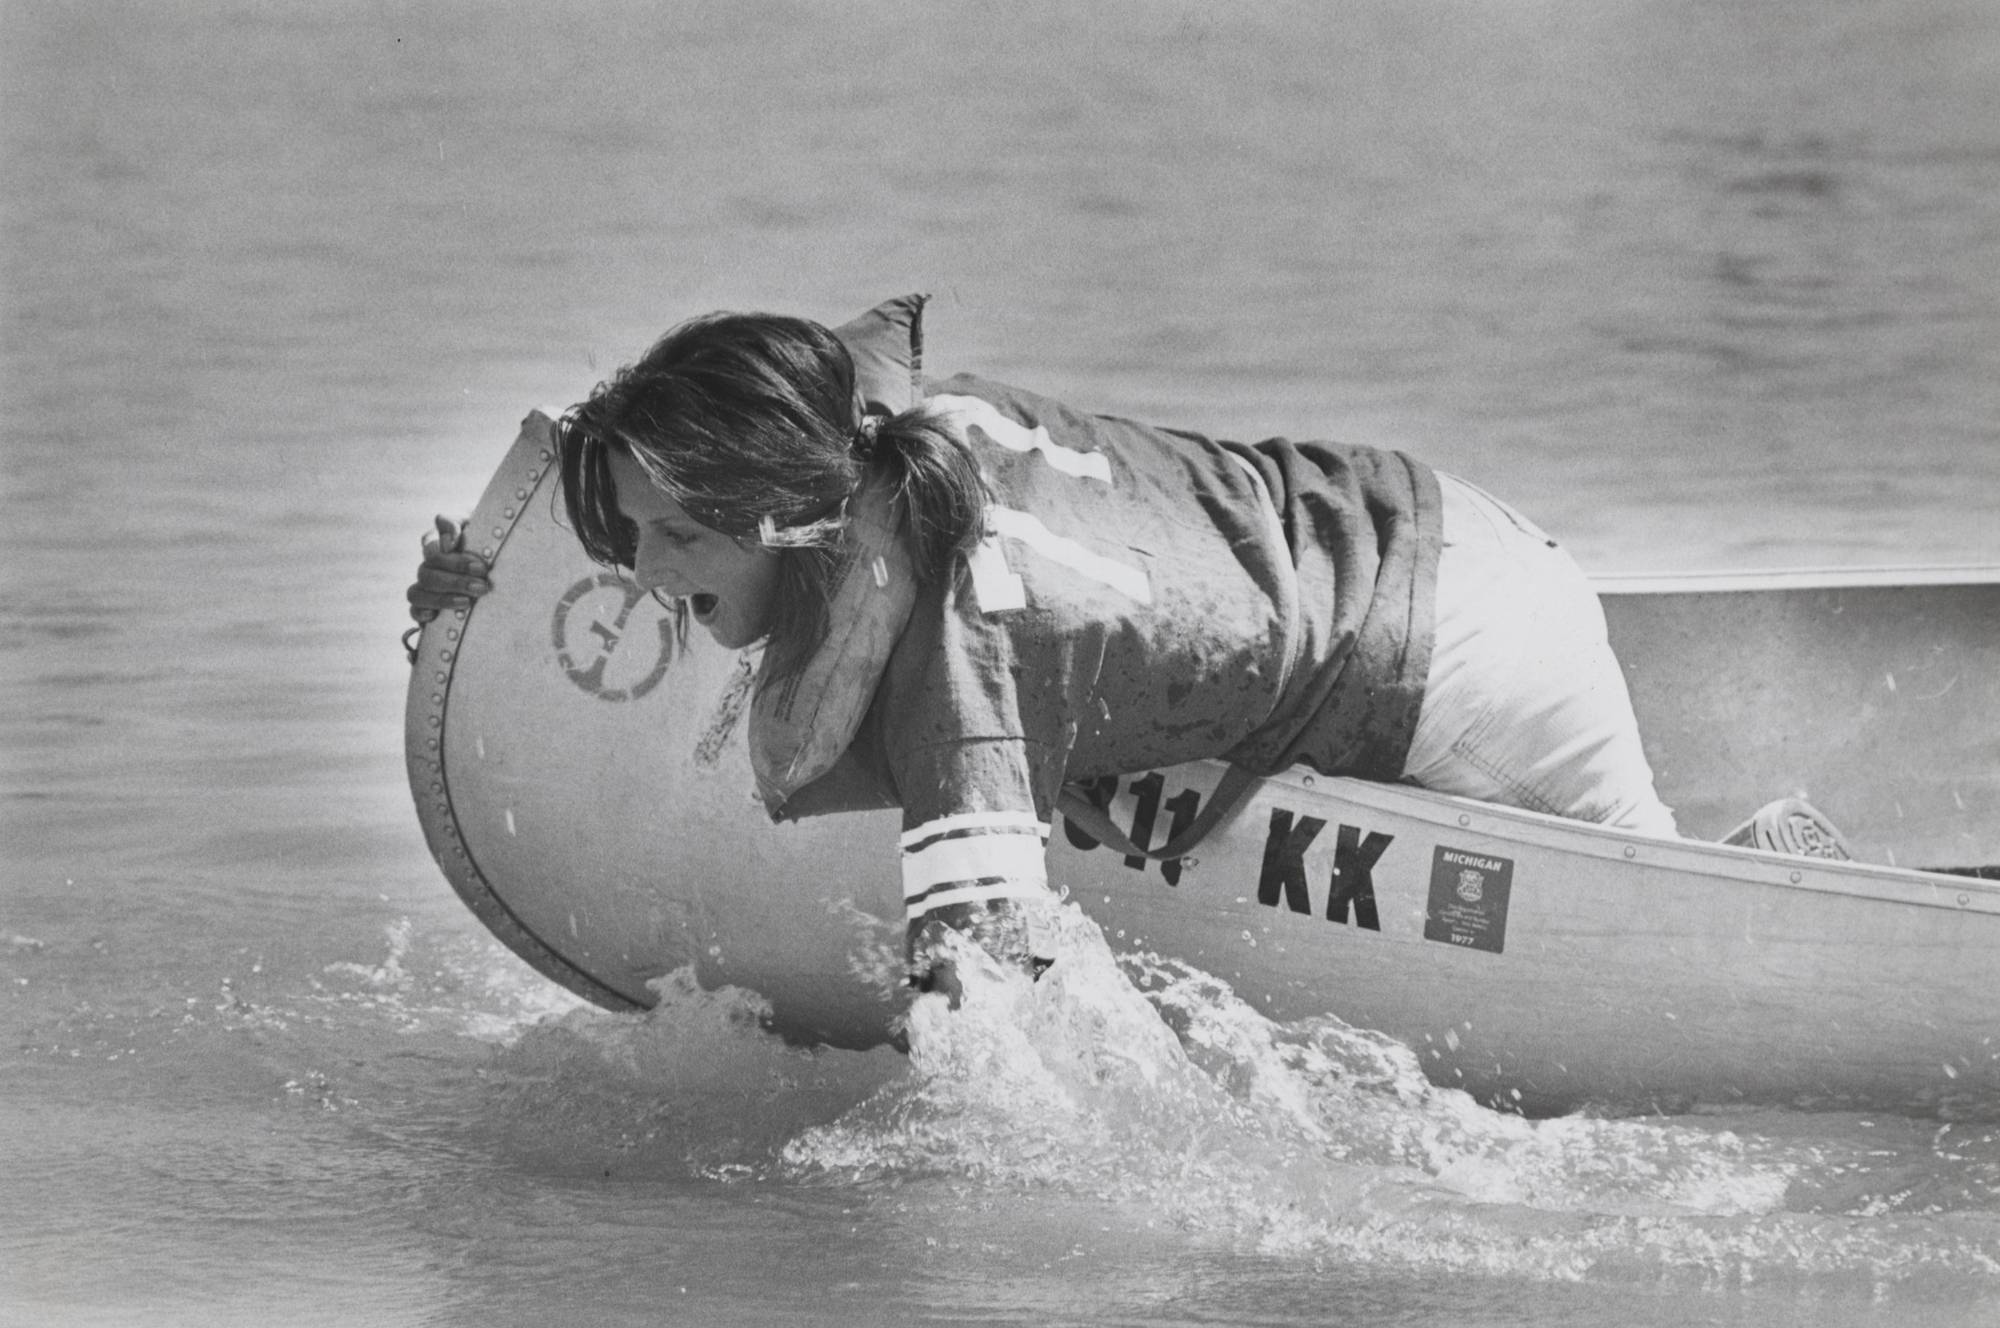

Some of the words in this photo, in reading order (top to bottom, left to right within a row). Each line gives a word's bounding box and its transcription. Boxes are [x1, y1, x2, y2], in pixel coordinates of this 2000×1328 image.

[1258, 807, 1395, 932] KK
[1443, 851, 1502, 872] MICHIGAN
[1451, 933, 1475, 946] 1977
